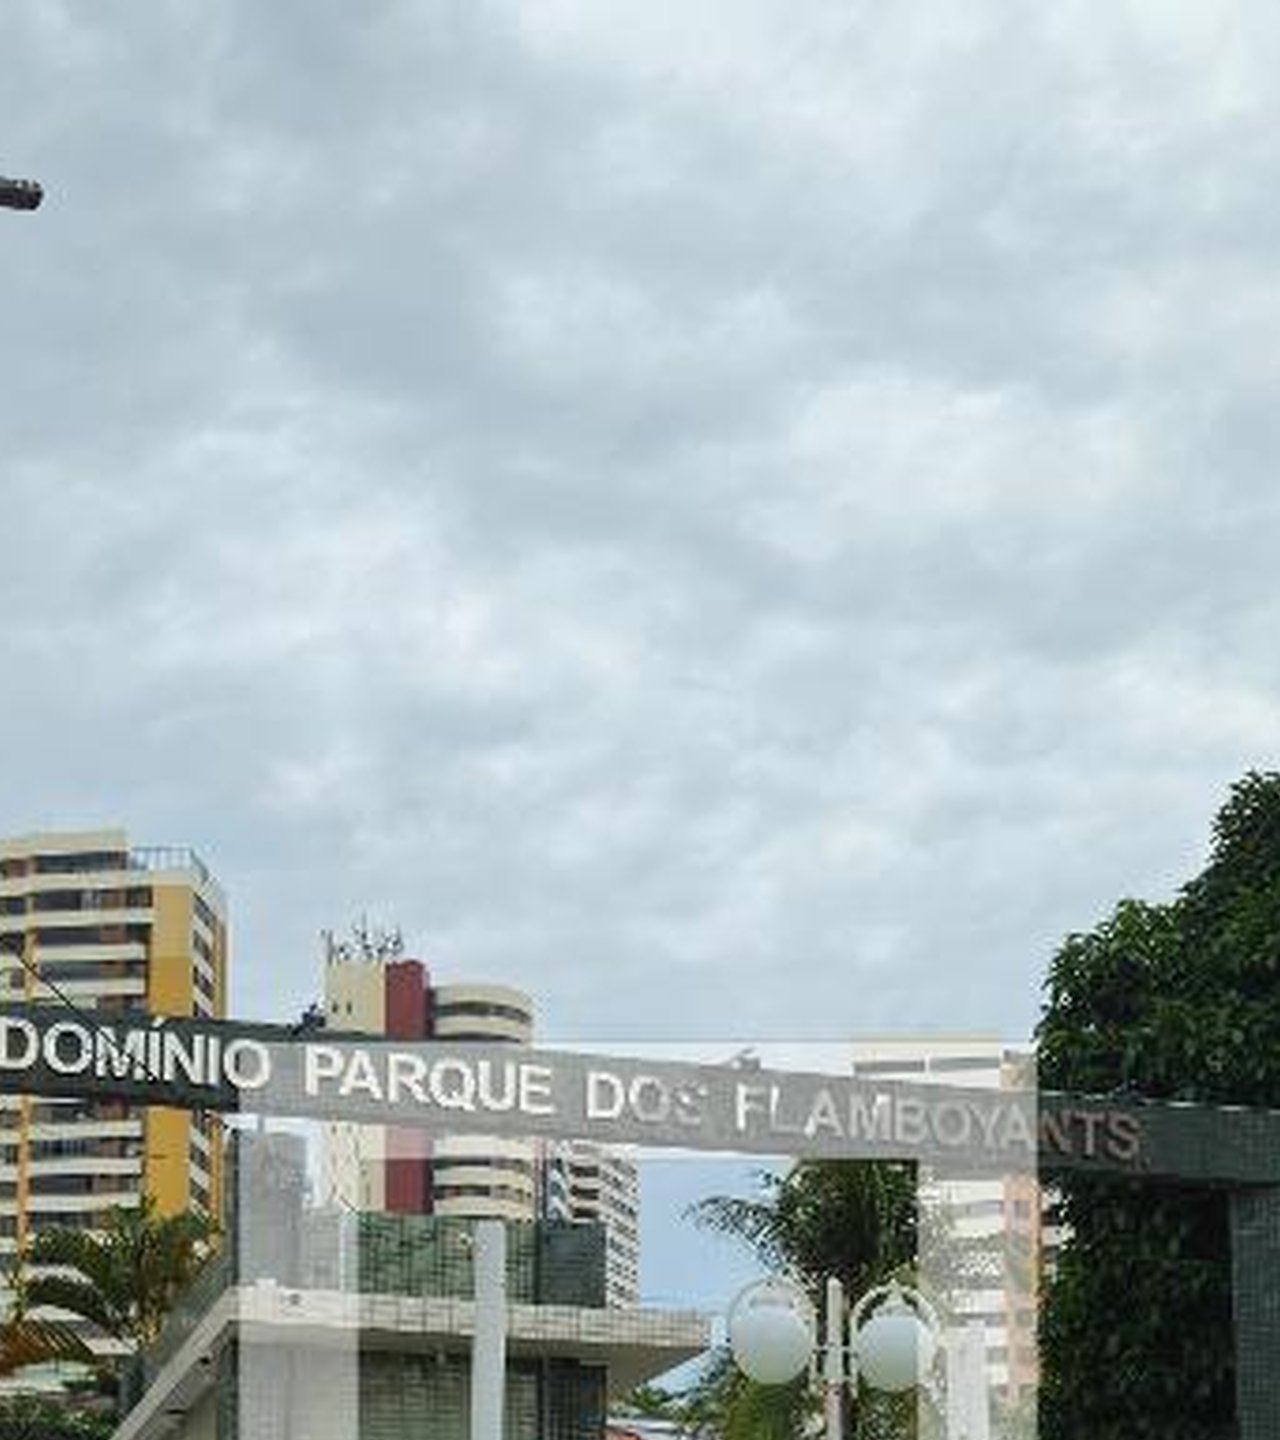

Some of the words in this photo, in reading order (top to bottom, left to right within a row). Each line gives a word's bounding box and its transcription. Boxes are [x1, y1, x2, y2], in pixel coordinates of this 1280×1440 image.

[303, 1043, 558, 1113] PARQUE
[586, 1070, 710, 1125] DOS
[733, 1082, 1144, 1162] FLAMBOYANTS
